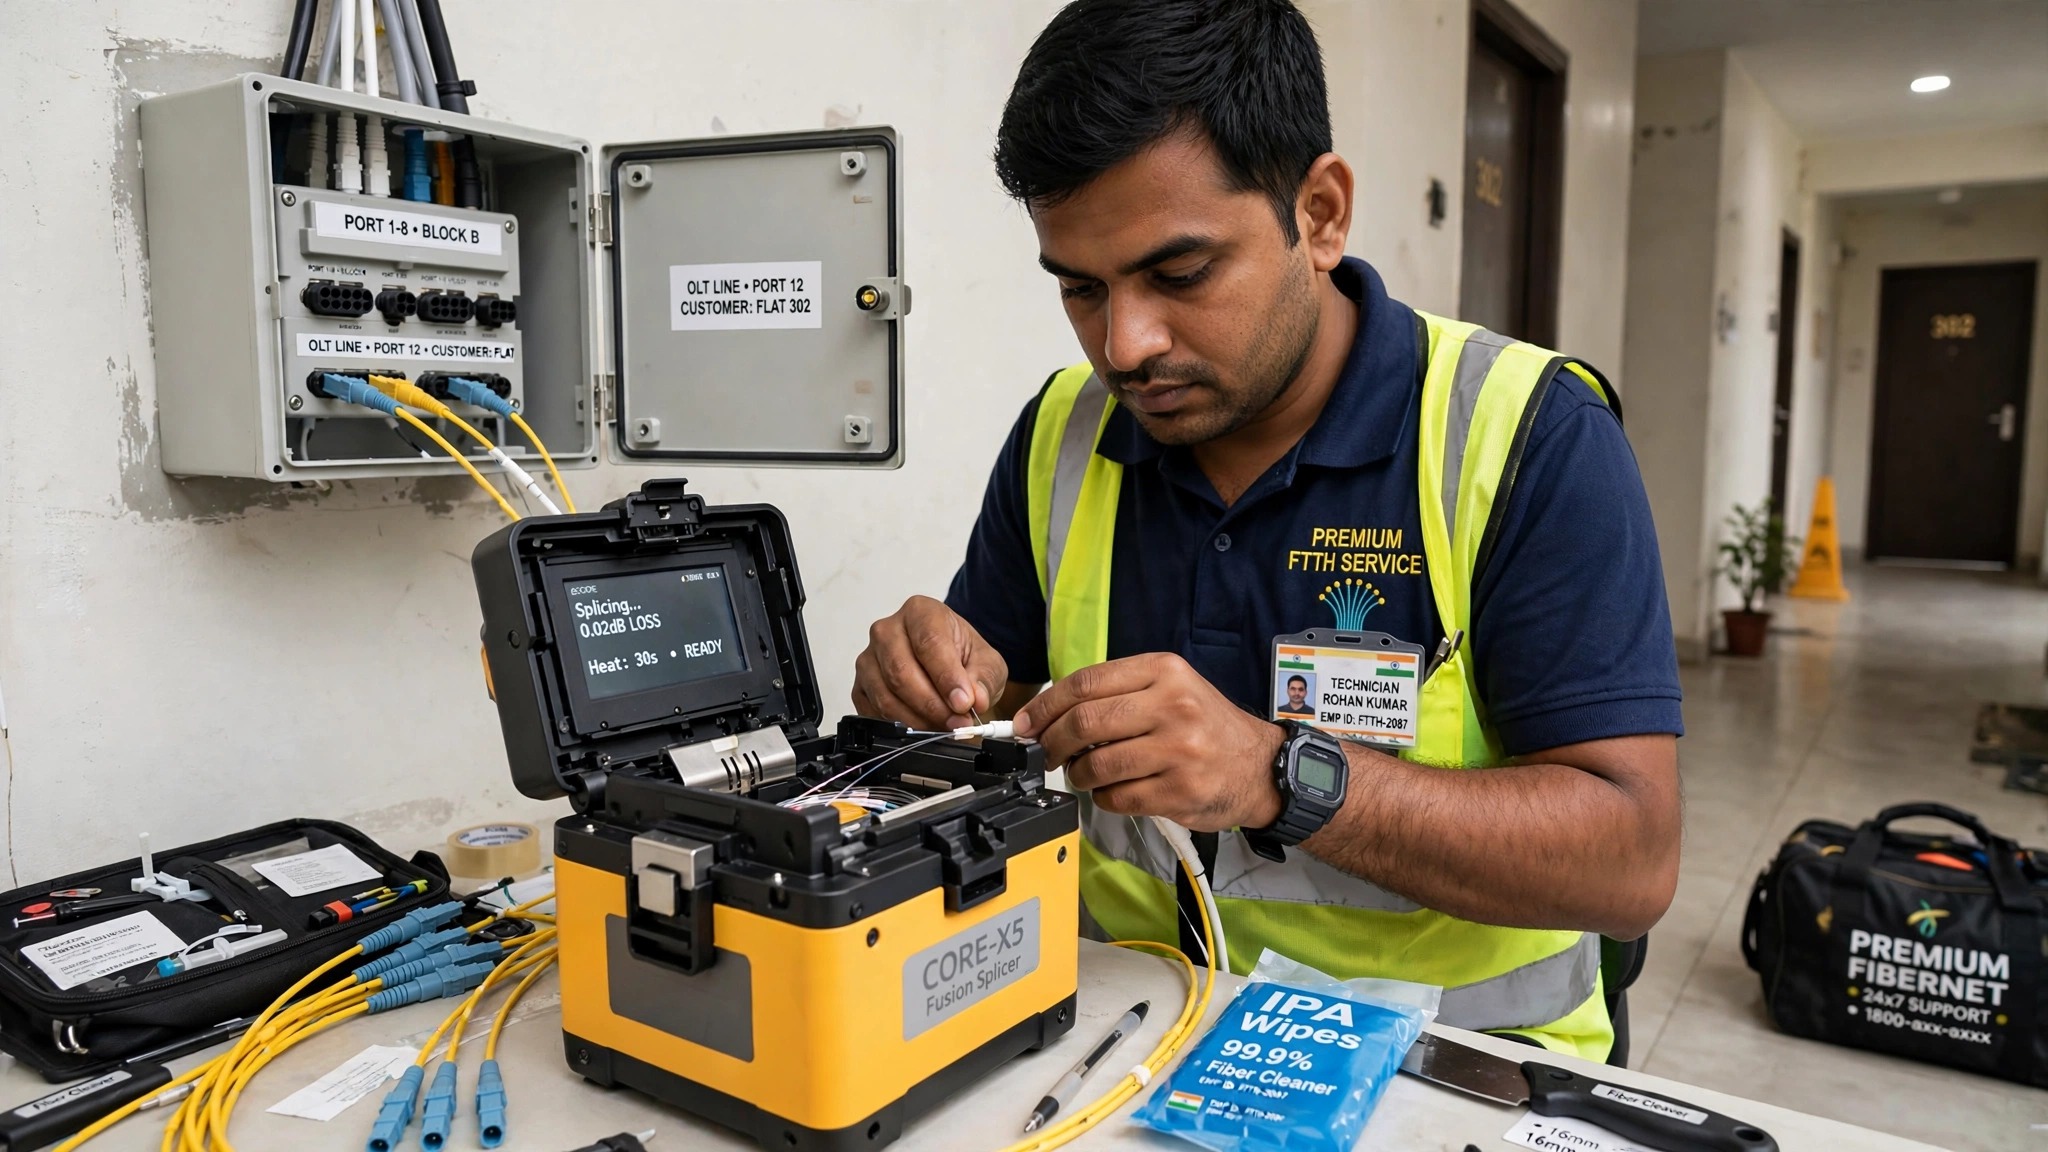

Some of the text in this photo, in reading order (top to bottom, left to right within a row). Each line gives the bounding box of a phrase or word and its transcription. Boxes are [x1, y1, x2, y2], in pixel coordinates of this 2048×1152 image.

[344, 214, 480, 244] PORT 1-8 BLOCK B
[687, 278, 804, 295] OLT LINE PORT 12
[680, 298, 811, 316] CUSTOMER: FLAT 302
[308, 339, 332, 352] OLT
[335, 340, 362, 353] LINE
[374, 342, 406, 355] PORT
[408, 343, 421, 355] 12
[431, 344, 492, 358] CUSTOMER:
[1311, 527, 1403, 549] PREMIUM
[1288, 550, 1423, 575] FTTH SERVICE
[575, 598, 642, 620] Splicing...
[579, 613, 662, 638] 0.02dB LOSS
[588, 638, 722, 675] Heat: 30s READY
[1330, 677, 1400, 694] TECHNICIAN
[1322, 693, 1408, 711] ROHAN KUMAR
[1320, 711, 1408, 730] EMP ID: FTTH-2087
[922, 916, 1024, 990] CORE-X5
[1850, 928, 2010, 980] PREMIUM
[926, 955, 1022, 1017] Fusion Splicer
[1848, 955, 2009, 1006] FIBERNET
[1259, 991, 1354, 1028] IPA
[1862, 987, 1991, 1025] 24x7 SUPPORT
[1240, 1011, 1363, 1050] Wipes
[1219, 1039, 1313, 1071] 99.9%
[1205, 1060, 1338, 1096] Fiber Cleaner
[1549, 1127, 1600, 1150] 16mm
